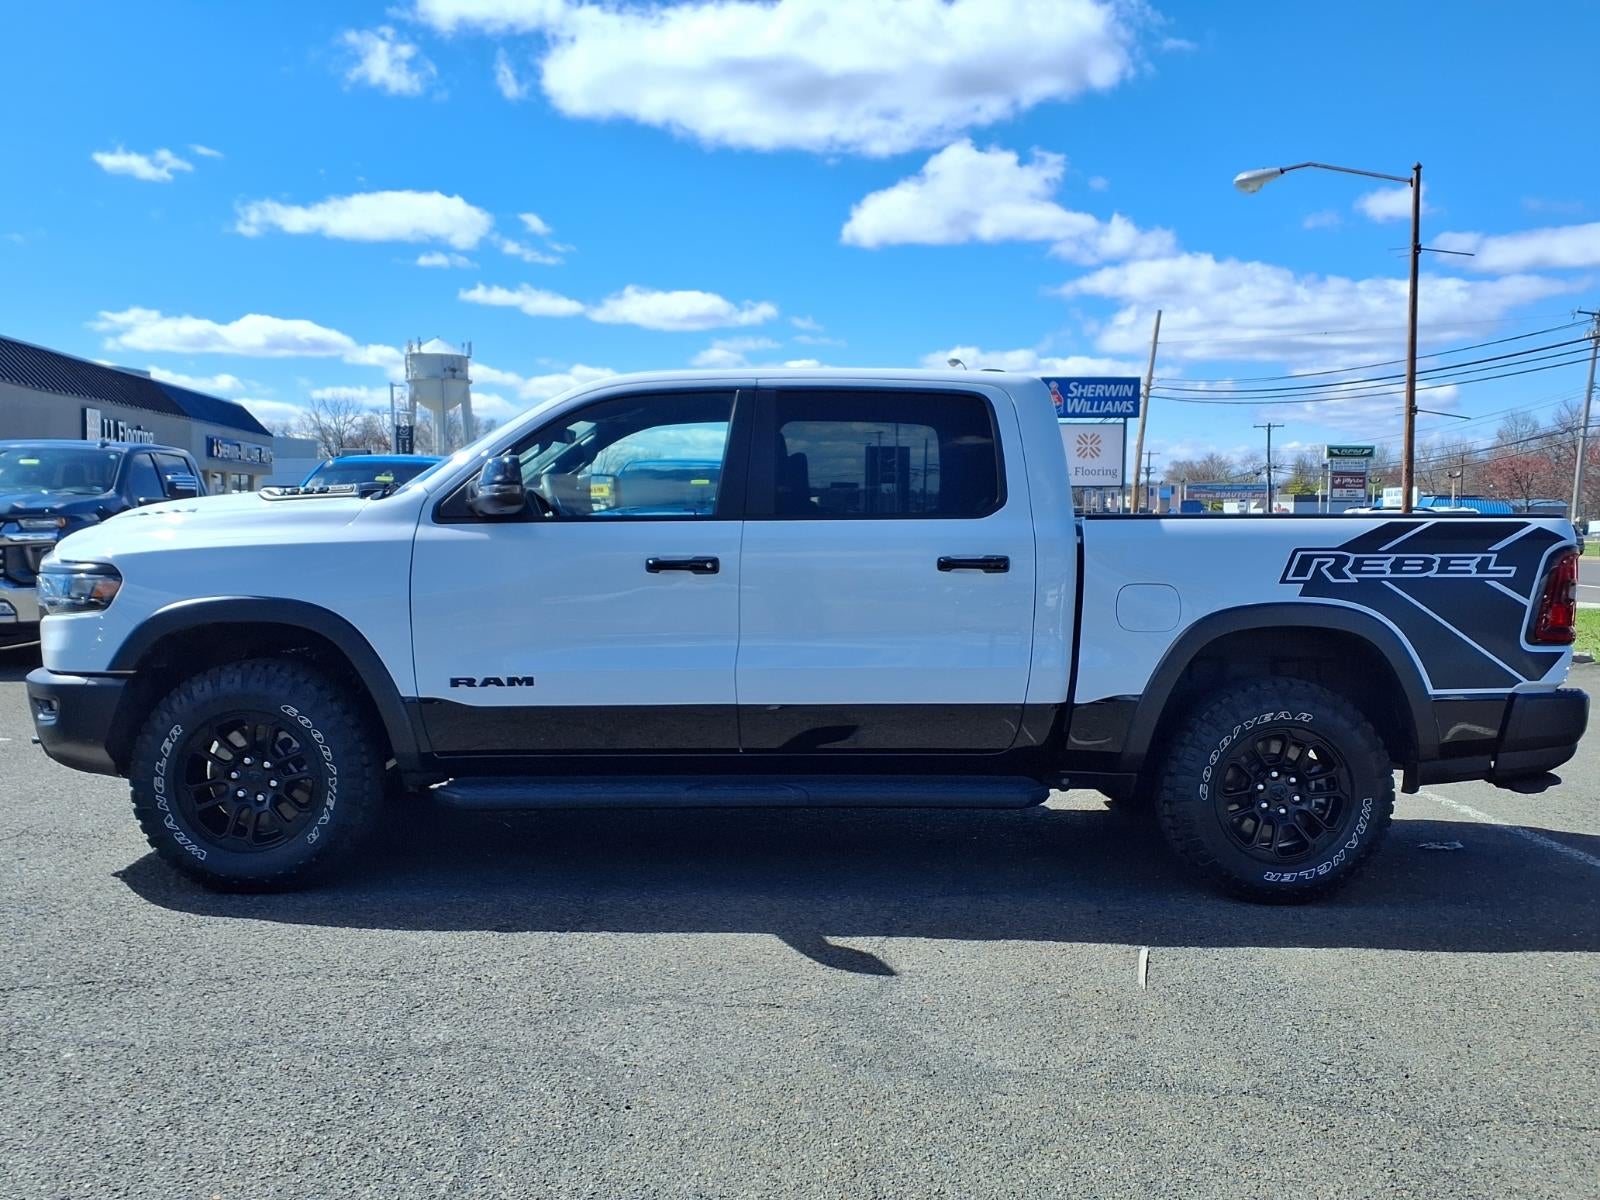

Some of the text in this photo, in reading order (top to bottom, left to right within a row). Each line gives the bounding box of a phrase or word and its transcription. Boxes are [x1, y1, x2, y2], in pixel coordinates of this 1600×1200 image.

[1067, 382, 1134, 397] SHERWIN
[1067, 399, 1134, 413] WILLIAMS
[103, 419, 117, 441] LL
[1074, 466, 1118, 478] Flooring
[1286, 550, 1517, 583] REBEL
[449, 676, 534, 688] RAM
[1199, 711, 1314, 800] GOODYEAR
[280, 704, 338, 845] GOODYEAR
[153, 724, 208, 861] WRANGLER
[1263, 797, 1373, 882] WRANGLER
